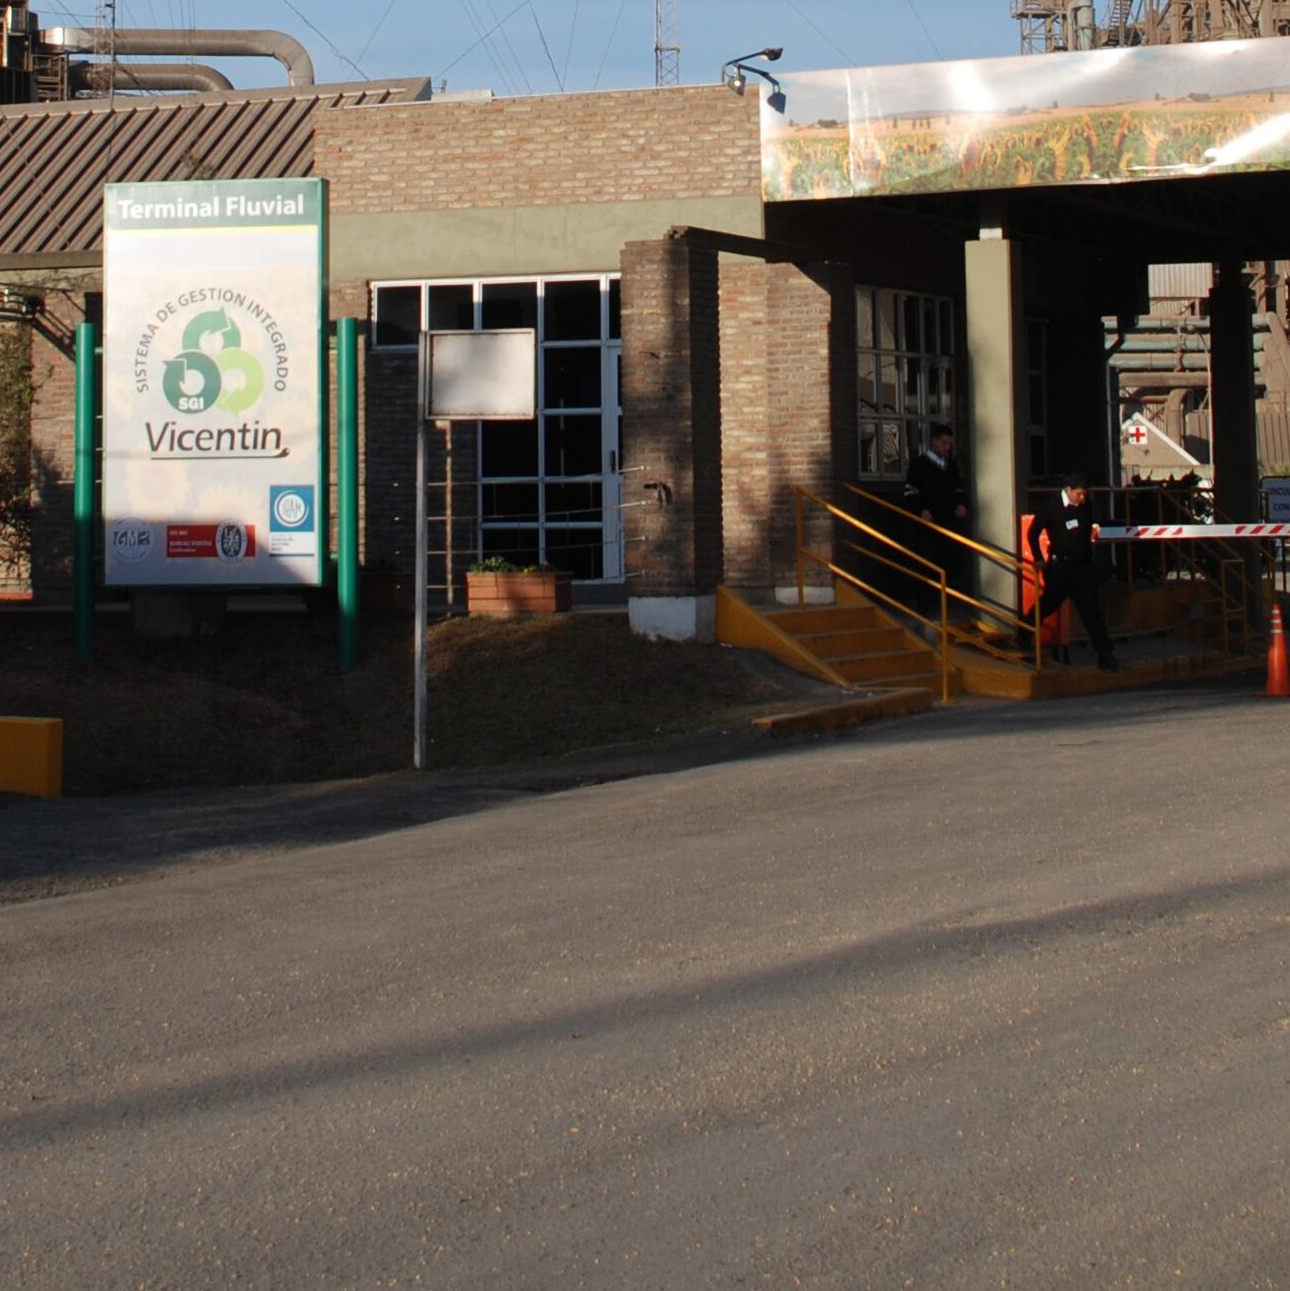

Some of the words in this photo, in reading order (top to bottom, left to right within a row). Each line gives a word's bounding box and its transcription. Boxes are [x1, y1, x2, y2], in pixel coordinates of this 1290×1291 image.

[118, 196, 220, 220] Terminal
[225, 193, 305, 217] Fluvial
[135, 323, 159, 393] SISTEMA
[156, 301, 177, 323] DE
[177, 287, 248, 307] GESTION
[247, 299, 289, 392] INTEGRADO
[178, 397, 204, 410] SGI
[145, 420, 283, 452] Vicentin
